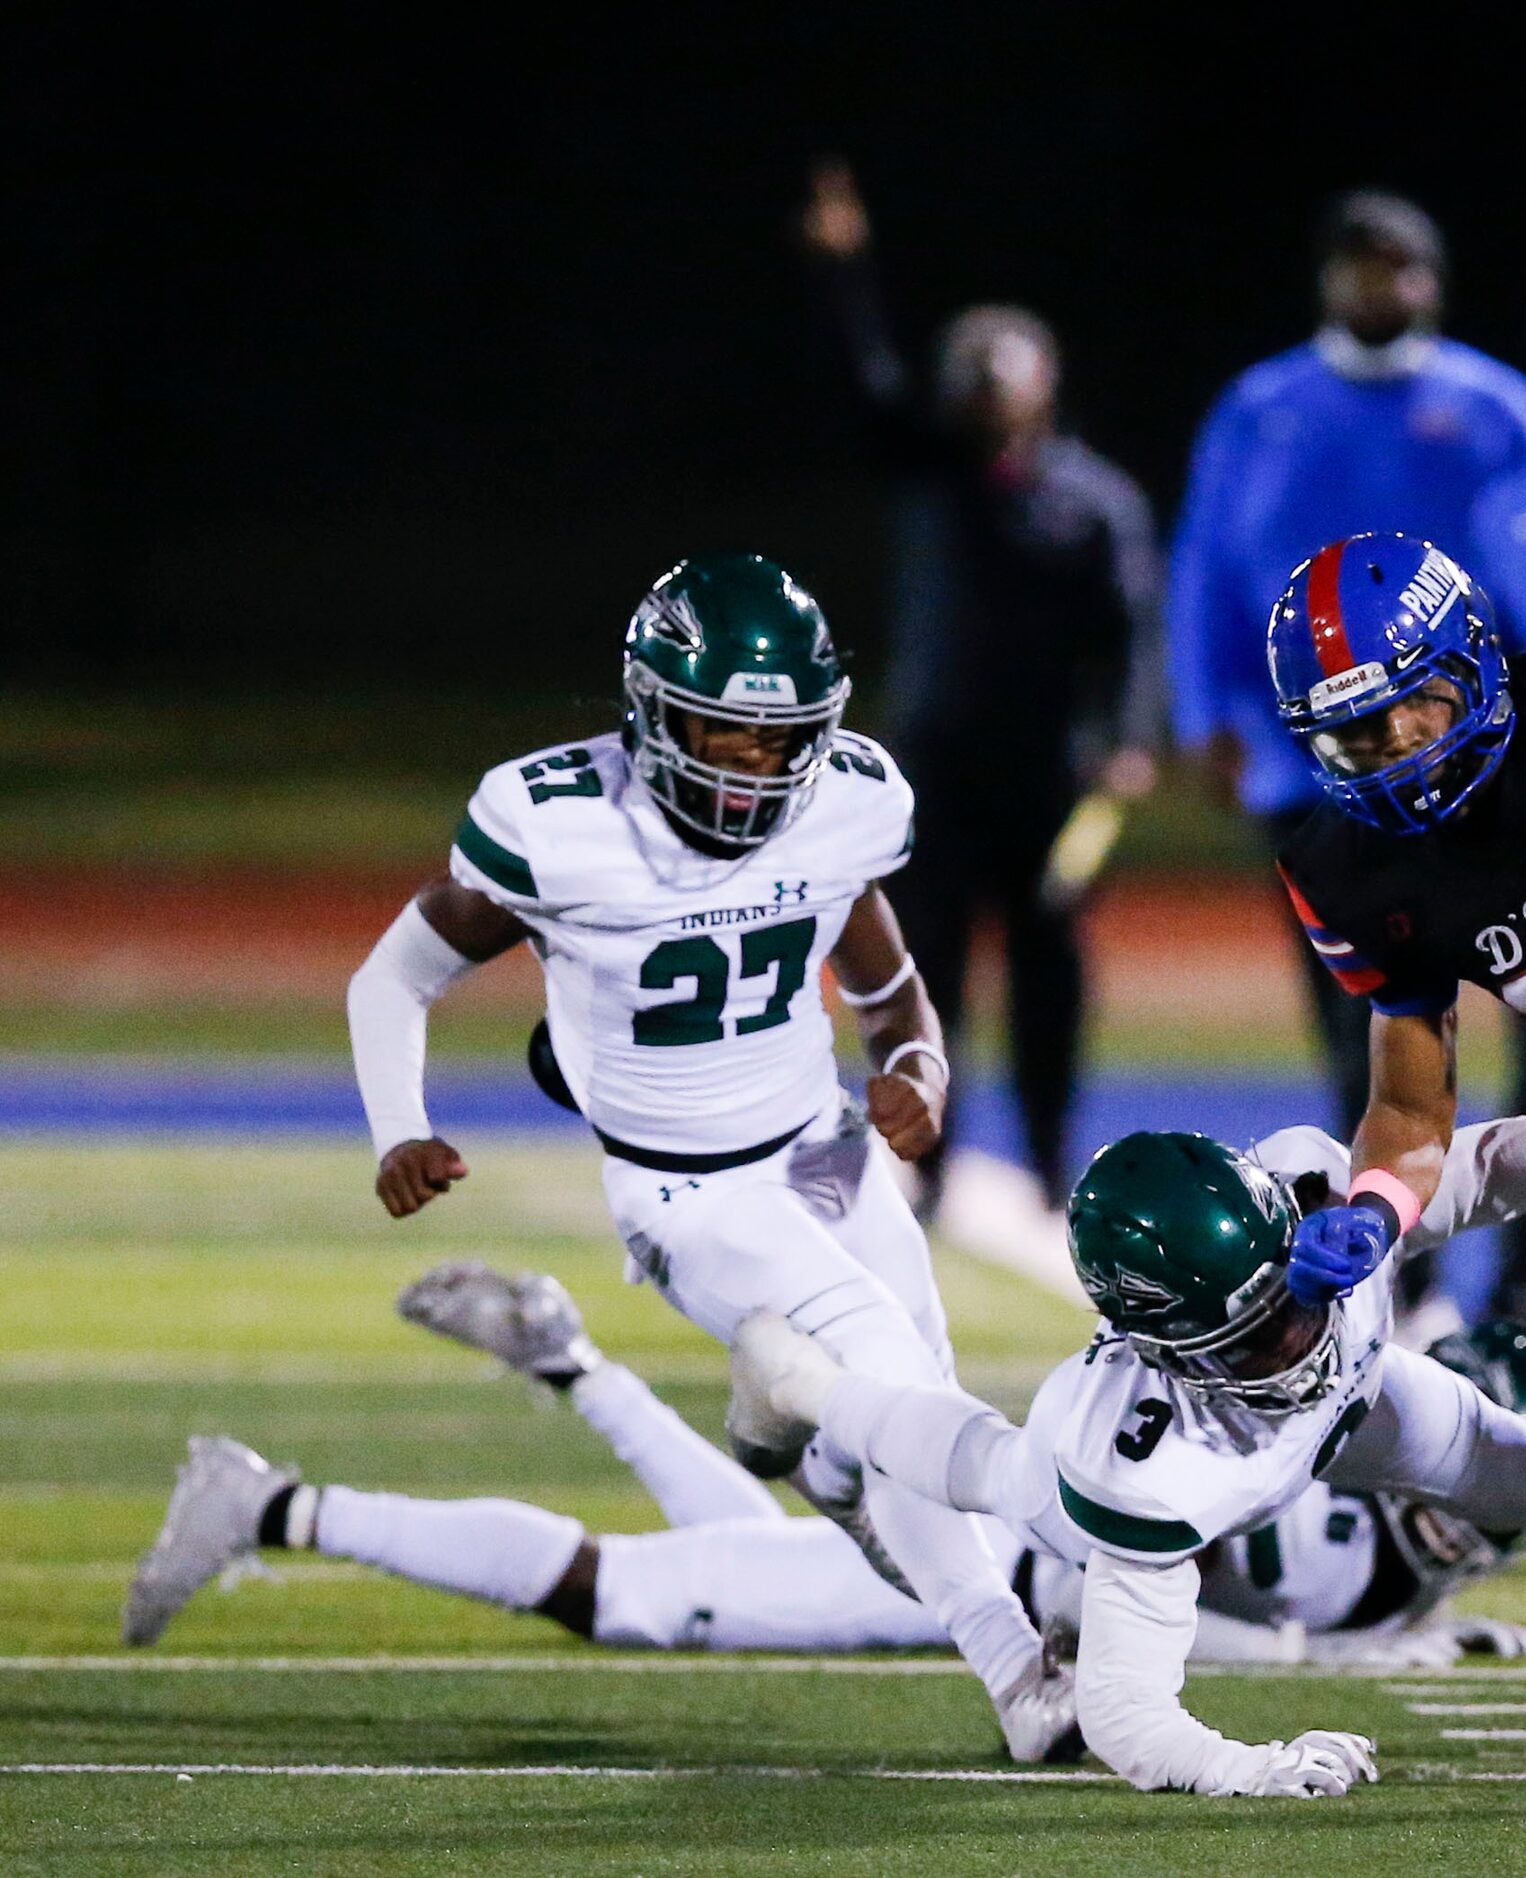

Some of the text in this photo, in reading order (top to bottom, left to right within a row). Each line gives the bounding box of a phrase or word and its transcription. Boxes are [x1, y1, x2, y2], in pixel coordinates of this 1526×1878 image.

[1326, 670, 1367, 695] Riddell
[520, 748, 604, 805] 27
[632, 914, 817, 1047] 27
[1115, 1397, 1174, 1462] 3
